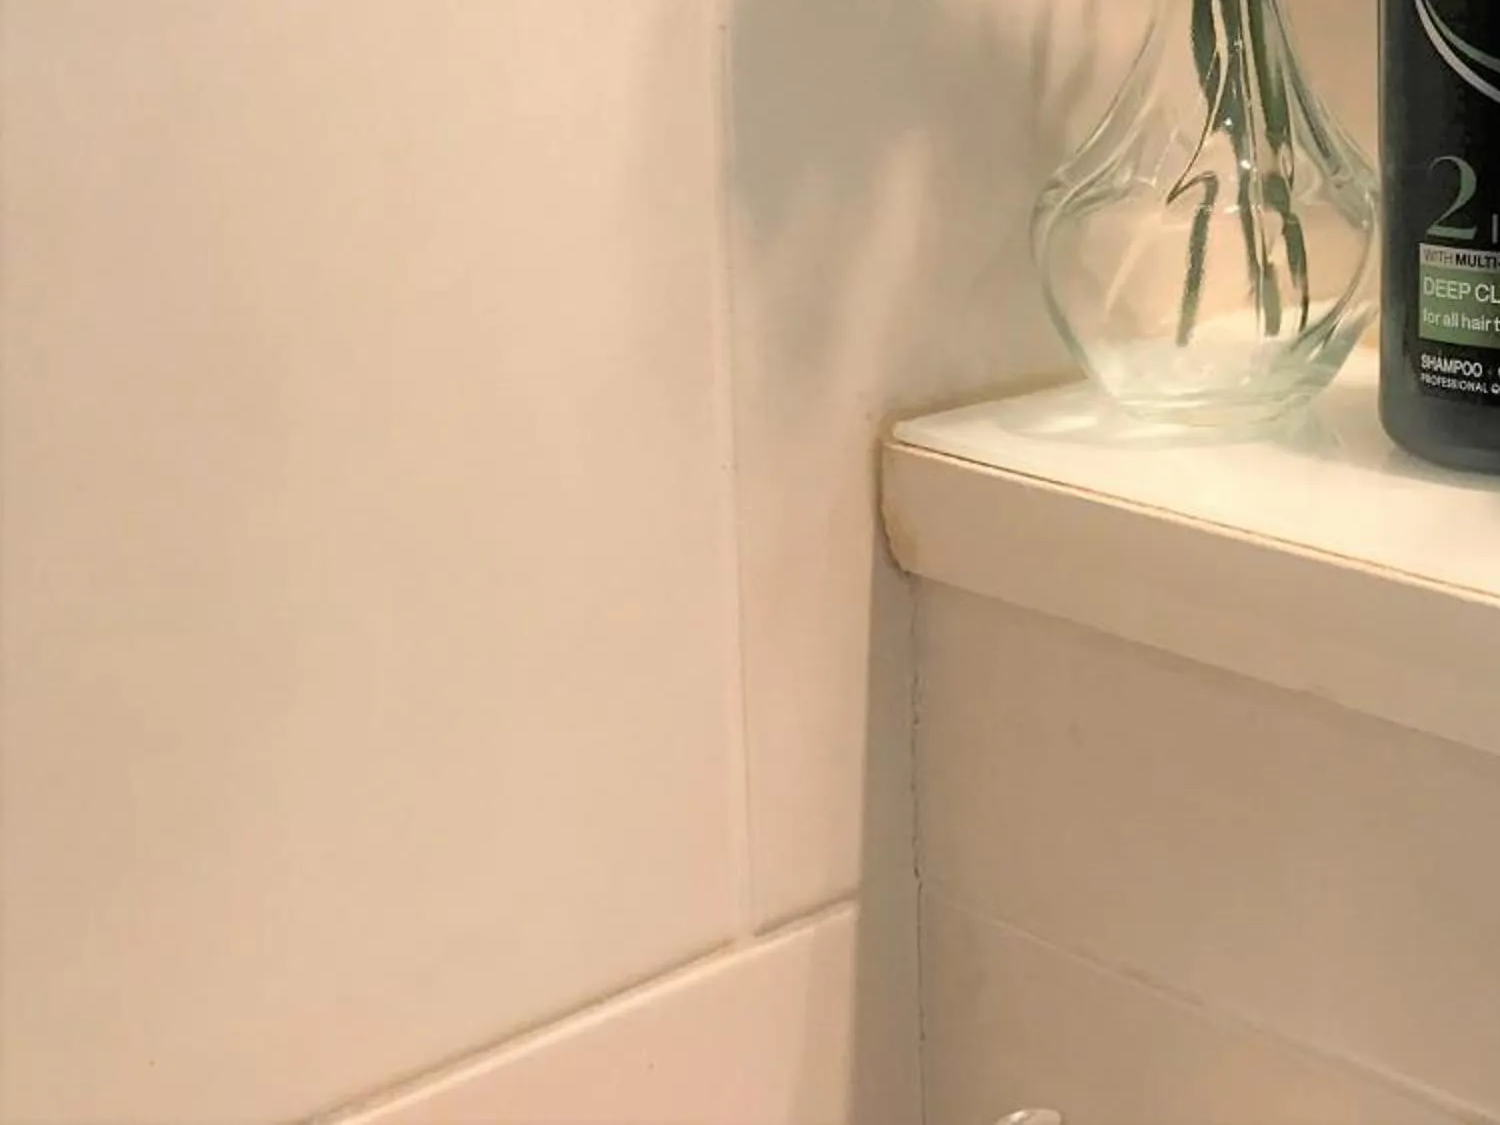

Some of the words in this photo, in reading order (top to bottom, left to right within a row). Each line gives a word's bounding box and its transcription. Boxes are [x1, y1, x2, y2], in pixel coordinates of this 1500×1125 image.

[1426, 155, 1477, 240] 2
[1423, 275, 1471, 300] DEEP
[1423, 308, 1441, 324] for
[1442, 312, 1460, 328] all
[1461, 313, 1493, 332] hair
[1421, 354, 1483, 378] SHAMPOO
